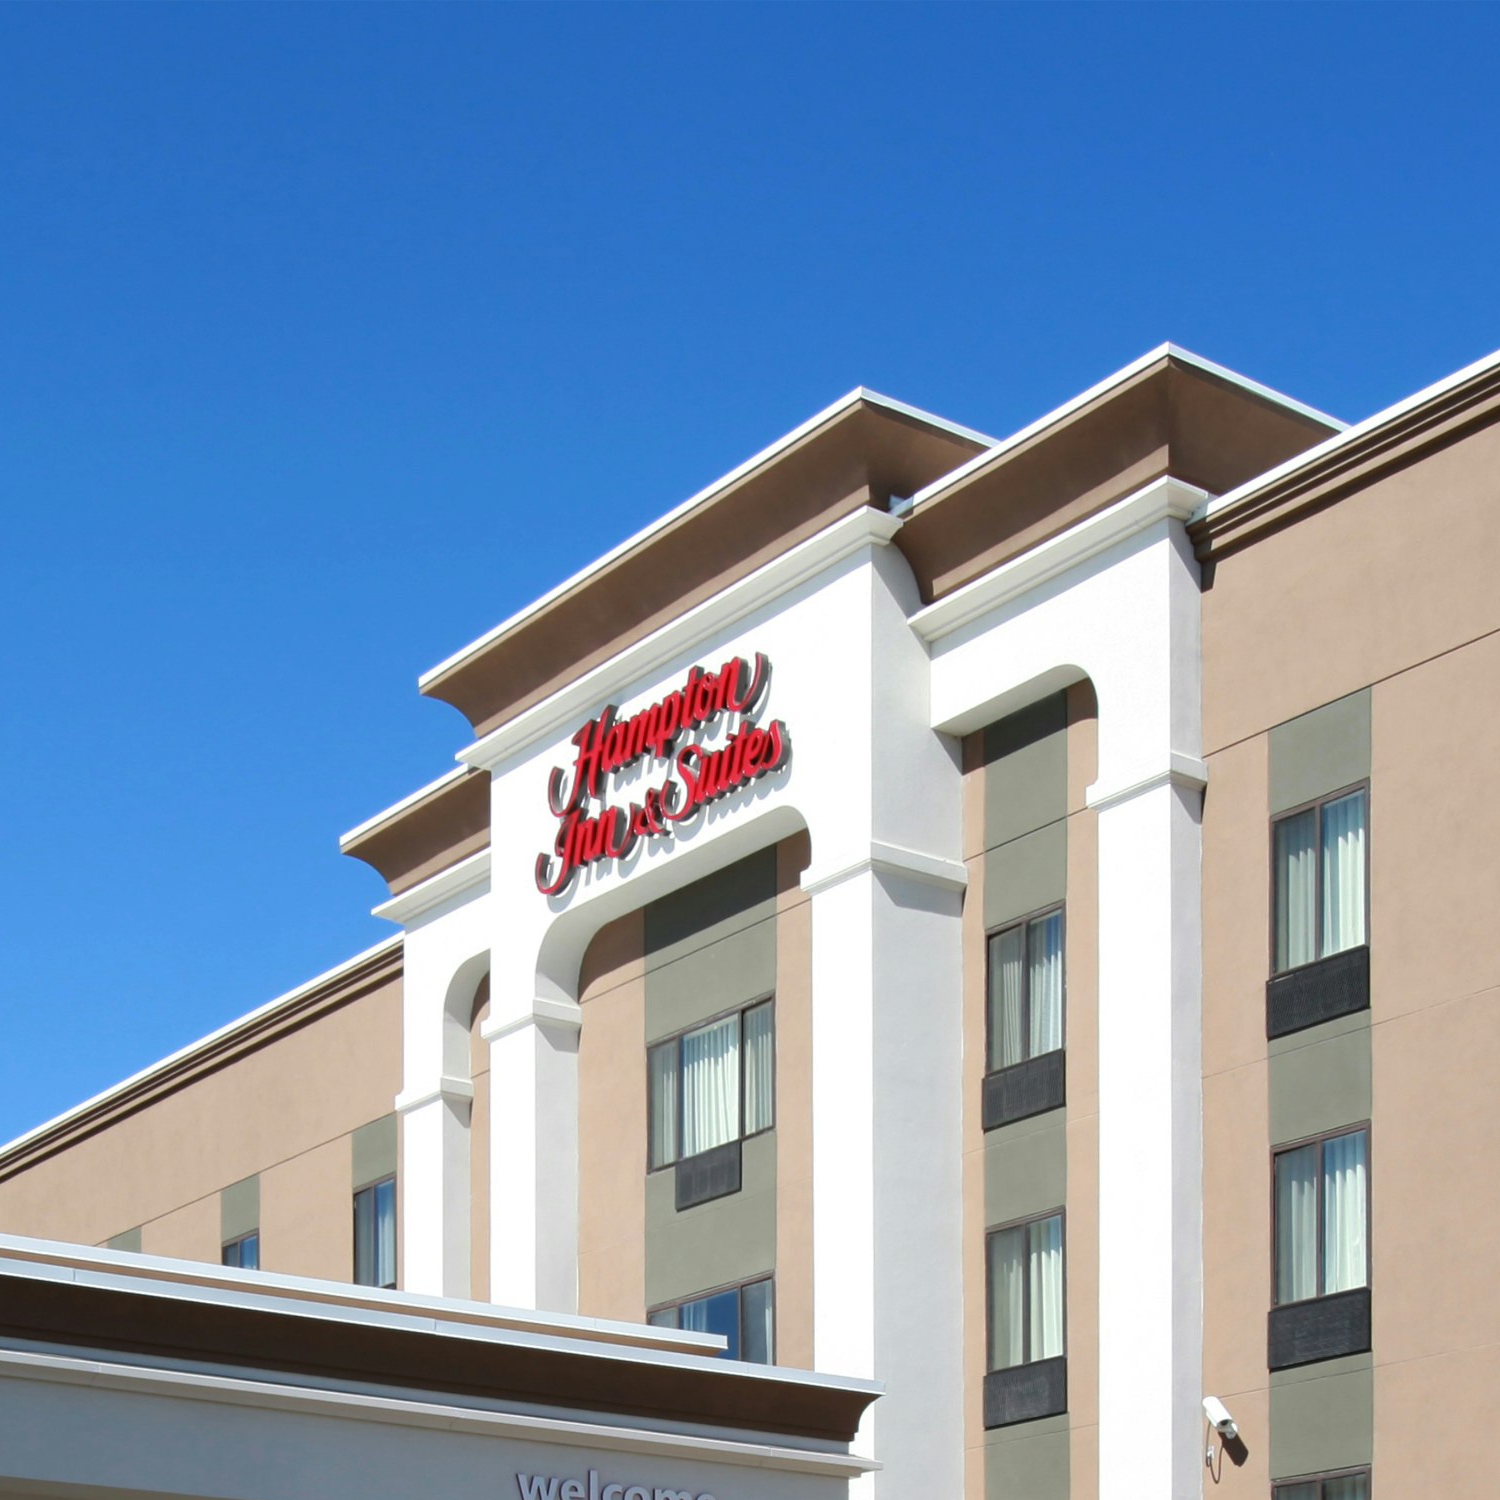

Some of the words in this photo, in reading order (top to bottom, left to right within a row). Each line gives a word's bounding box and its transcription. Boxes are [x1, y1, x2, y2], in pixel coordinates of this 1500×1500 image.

[535, 803, 640, 896] Inn
[634, 787, 673, 837] &
[659, 719, 788, 823] Suites
[548, 652, 770, 818] Hampton
